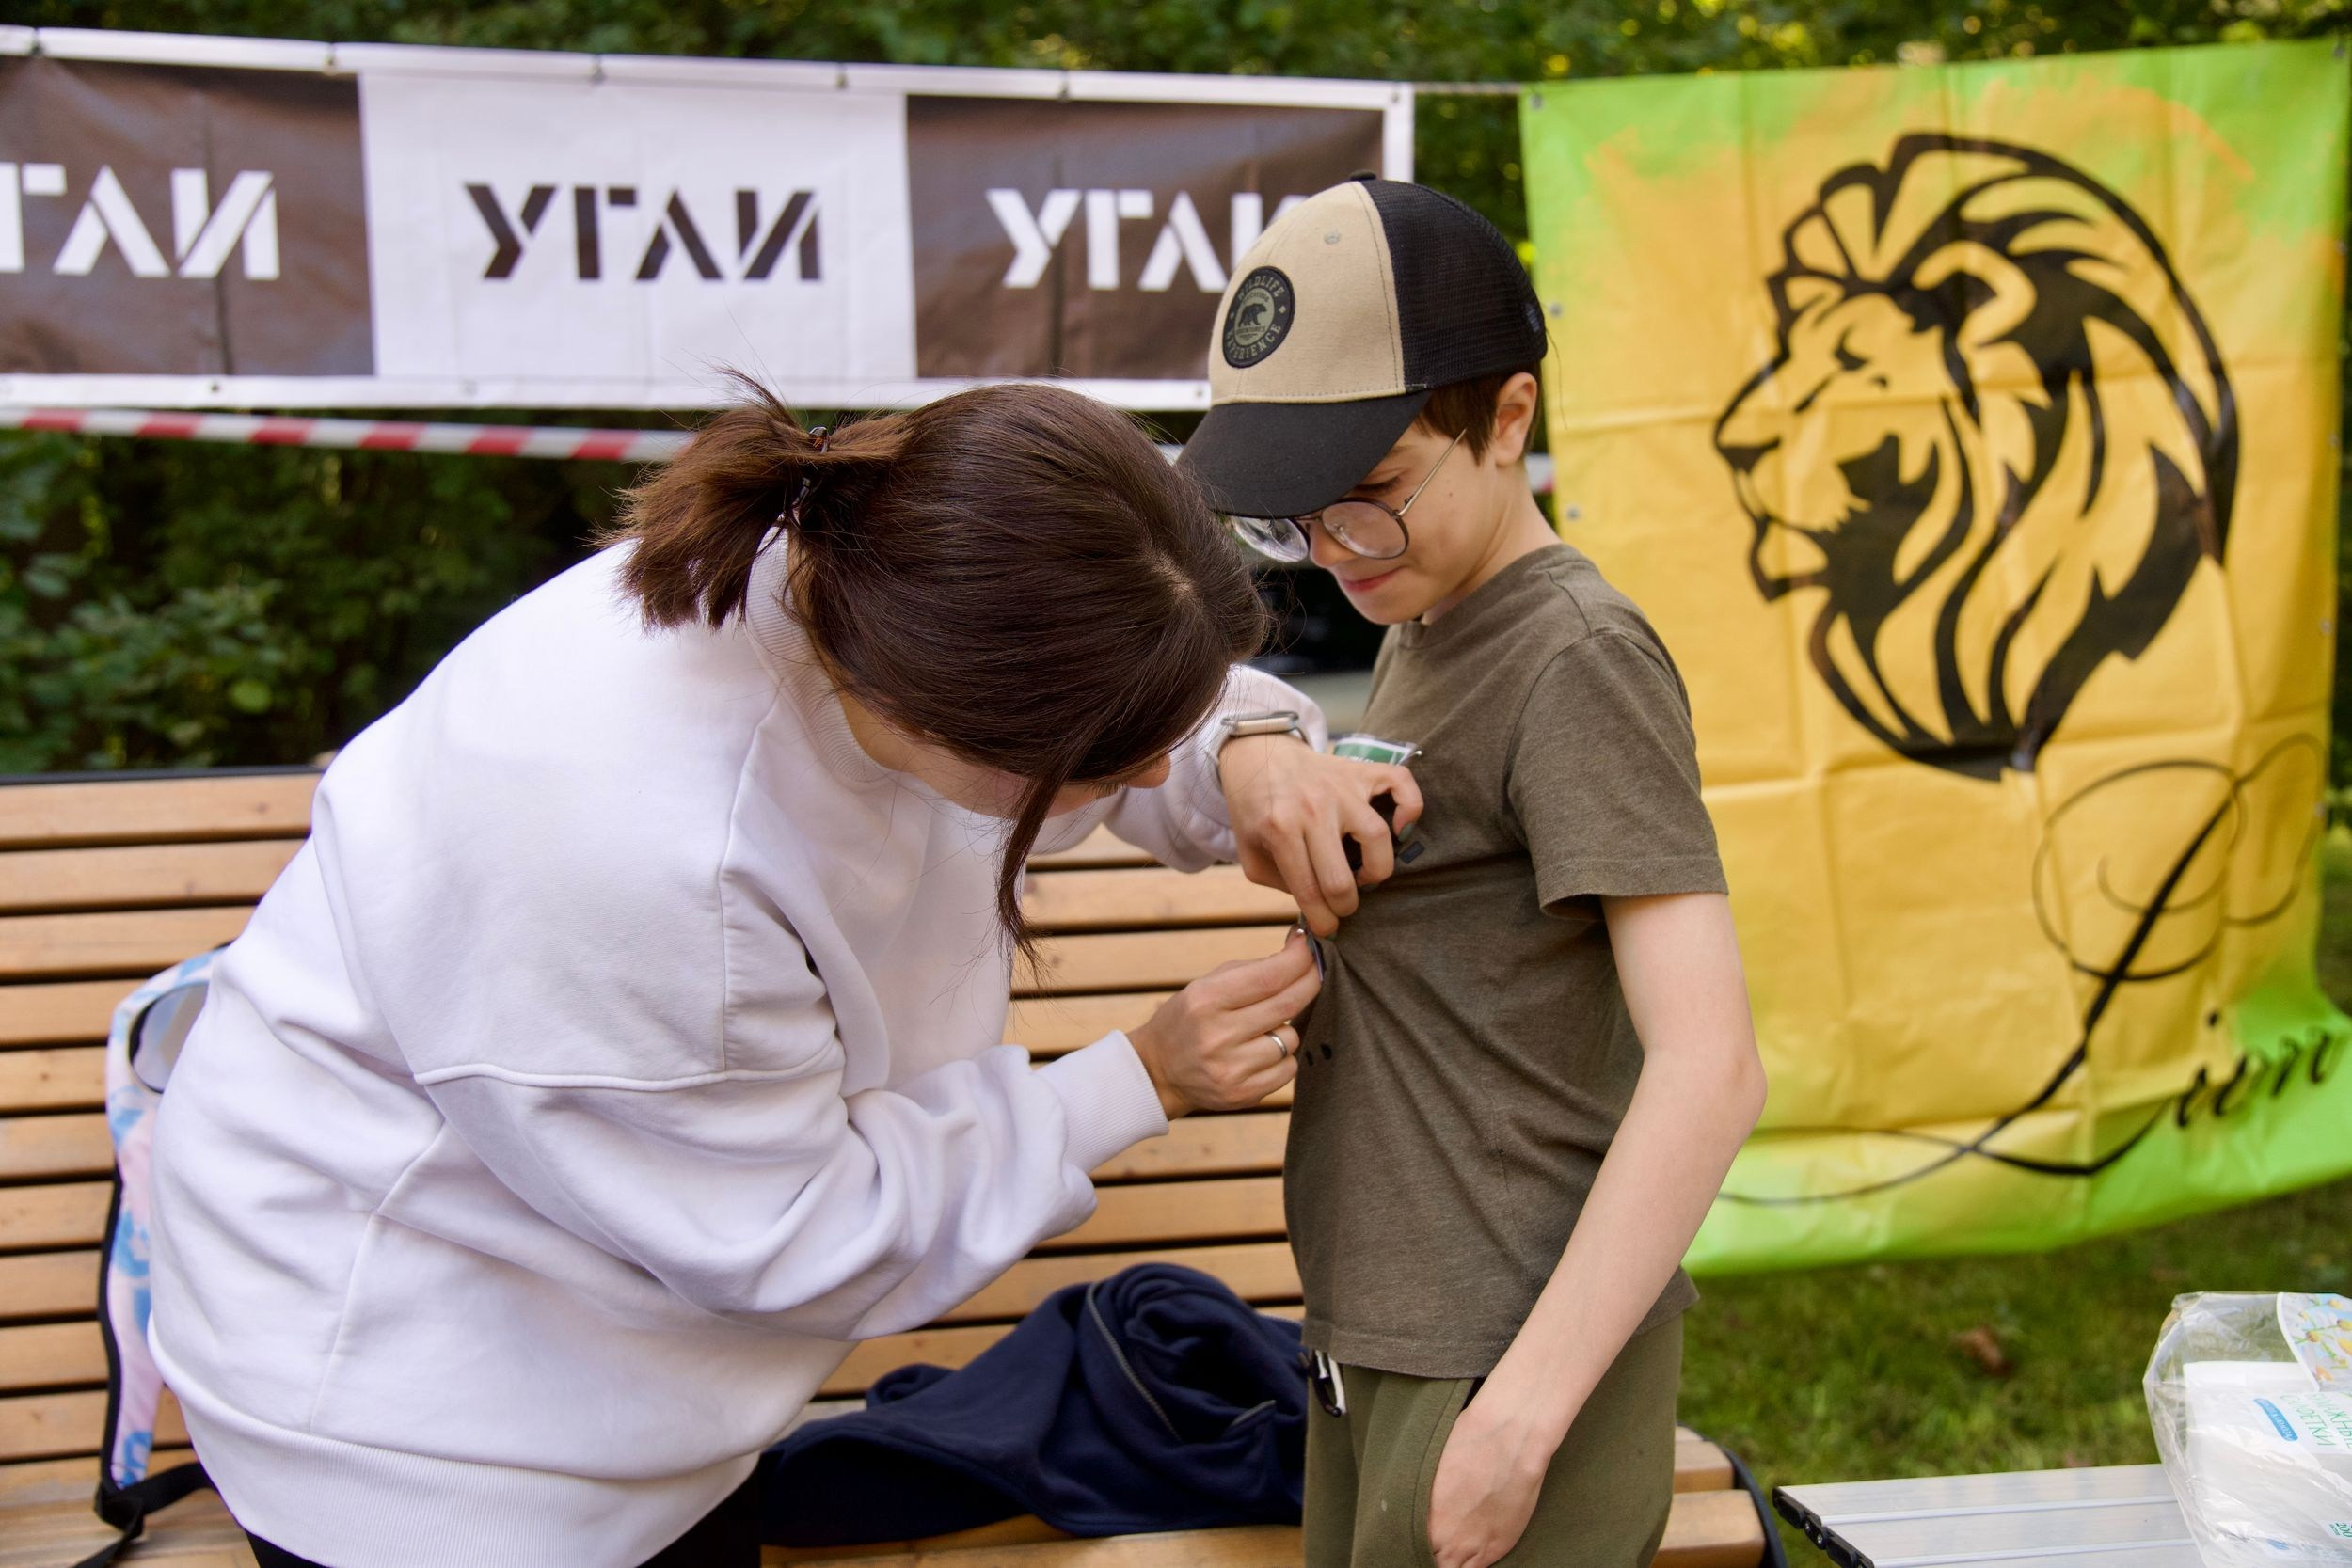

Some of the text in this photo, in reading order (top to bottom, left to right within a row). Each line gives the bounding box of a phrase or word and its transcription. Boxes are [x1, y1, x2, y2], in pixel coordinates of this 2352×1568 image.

[0, 162, 280, 280] ГЛИ
[1238, 275, 1285, 300] WILDLIFE
[1226, 324, 1282, 359] EXPERIENCE
